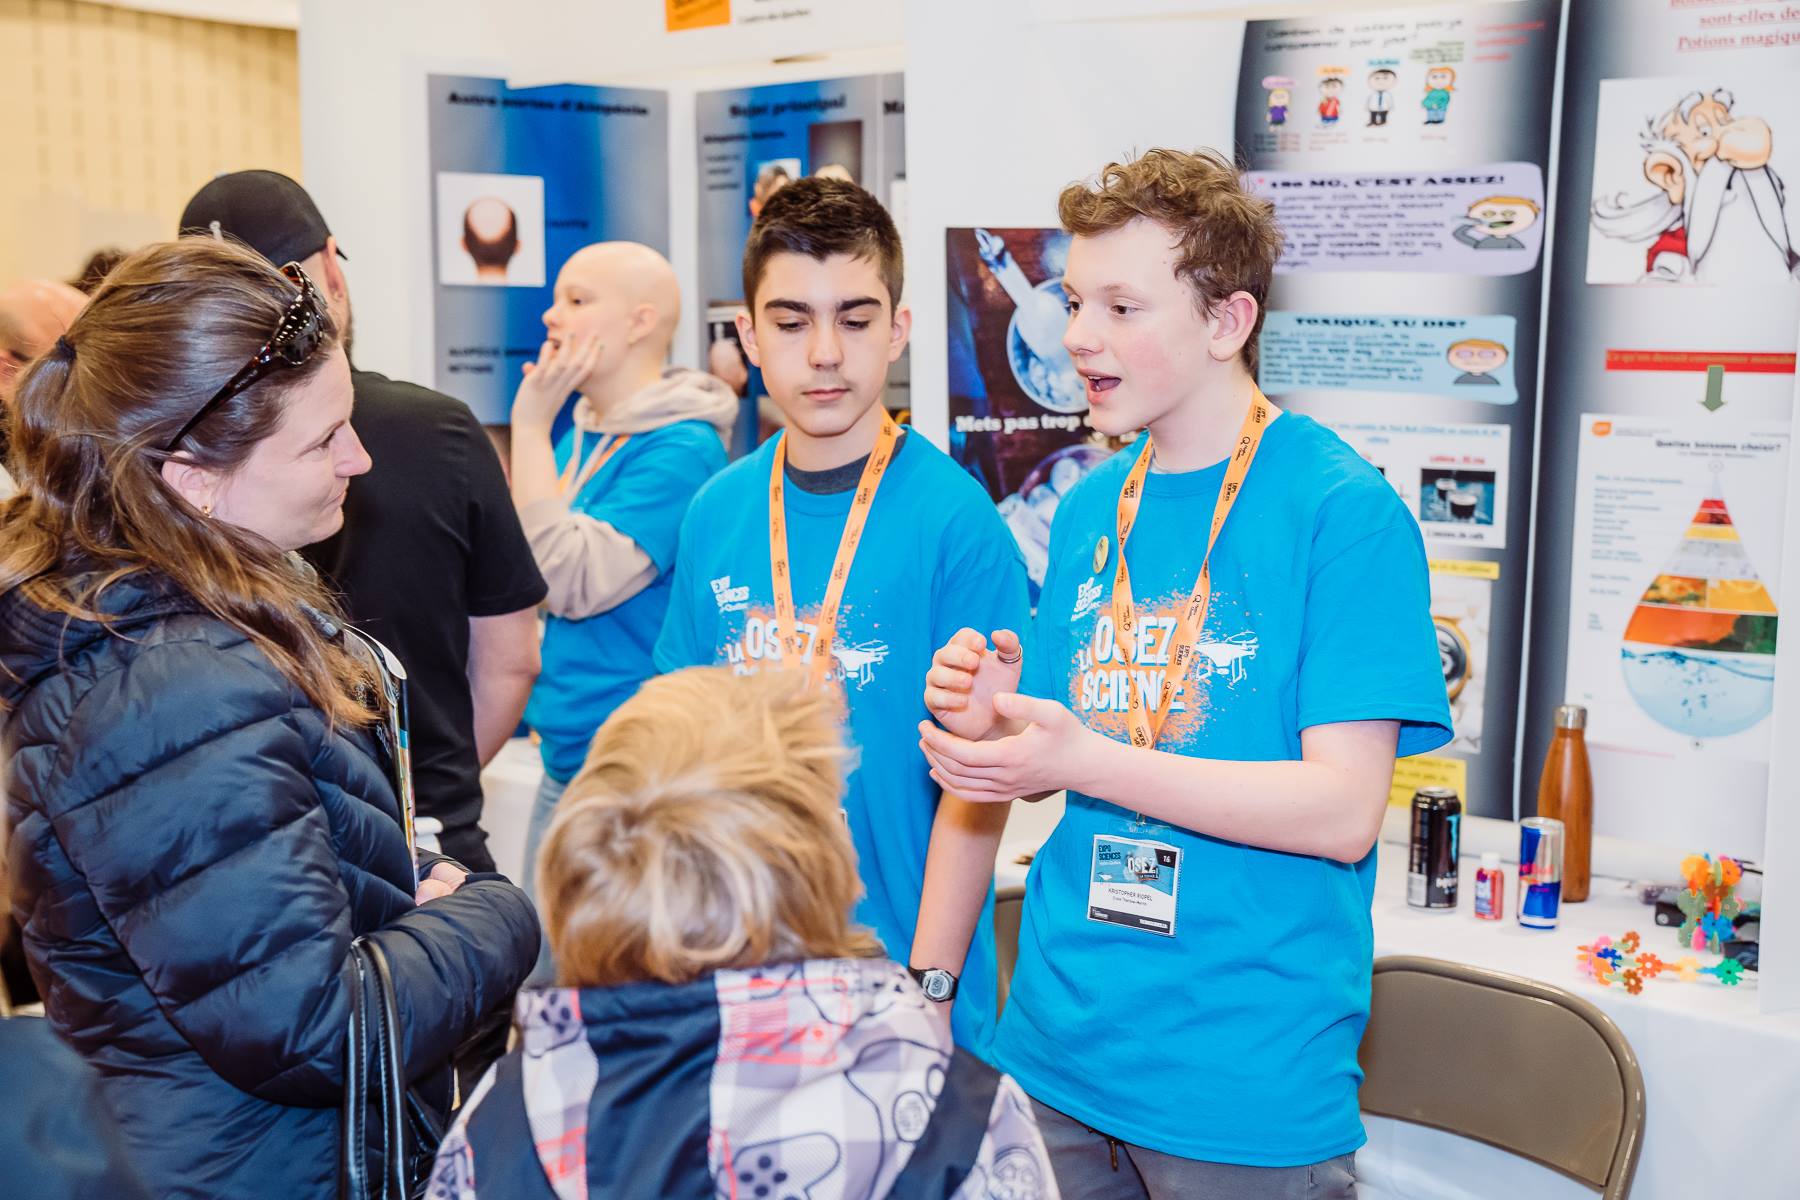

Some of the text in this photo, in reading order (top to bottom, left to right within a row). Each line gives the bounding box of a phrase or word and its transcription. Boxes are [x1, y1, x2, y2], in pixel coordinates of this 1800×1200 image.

[955, 415, 1002, 433] Mets
[1003, 416, 1039, 435] pas
[1041, 414, 1081, 433] trop
[1098, 852, 1121, 861] SCIENCES
